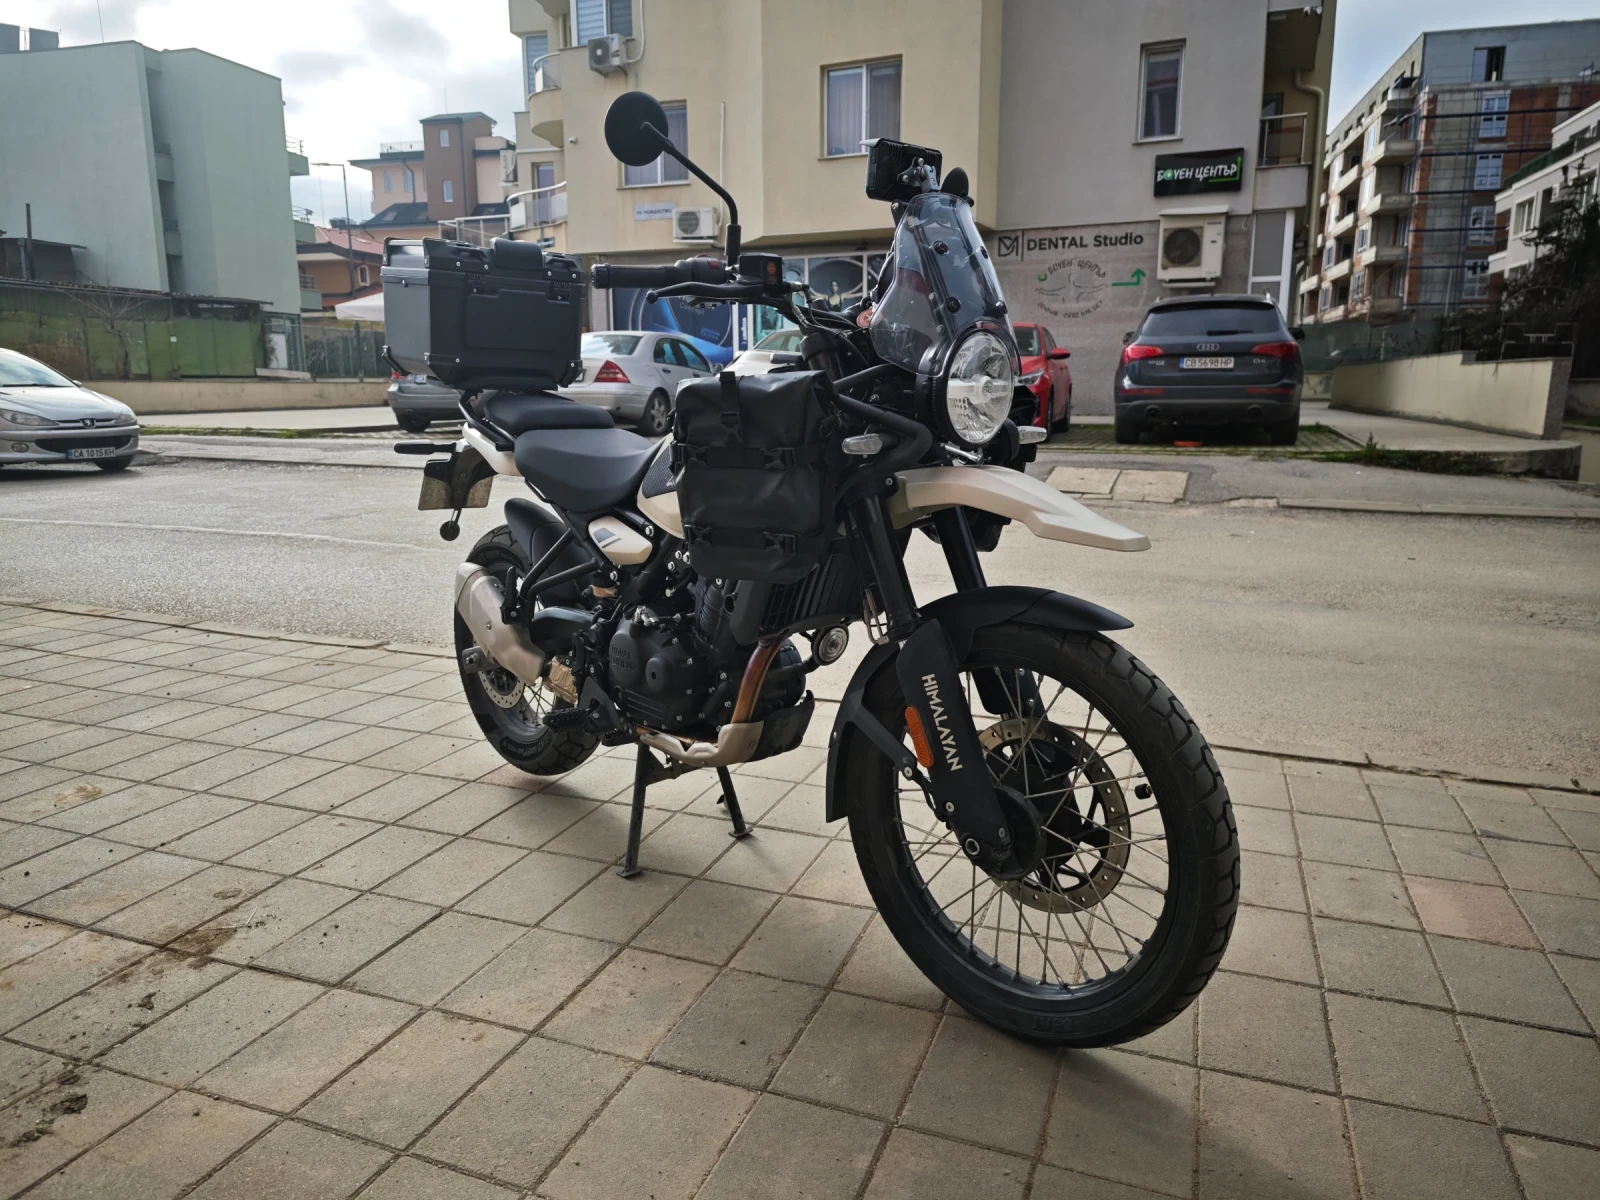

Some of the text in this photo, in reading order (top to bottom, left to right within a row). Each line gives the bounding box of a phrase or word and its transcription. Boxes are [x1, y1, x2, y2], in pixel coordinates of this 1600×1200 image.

[1194, 164, 1237, 182] ЦЕНТЪР
[1027, 232, 1144, 251] DENTAL Studio
[86, 449, 104, 458] 1015
[921, 673, 963, 772] HIMALAYAN
